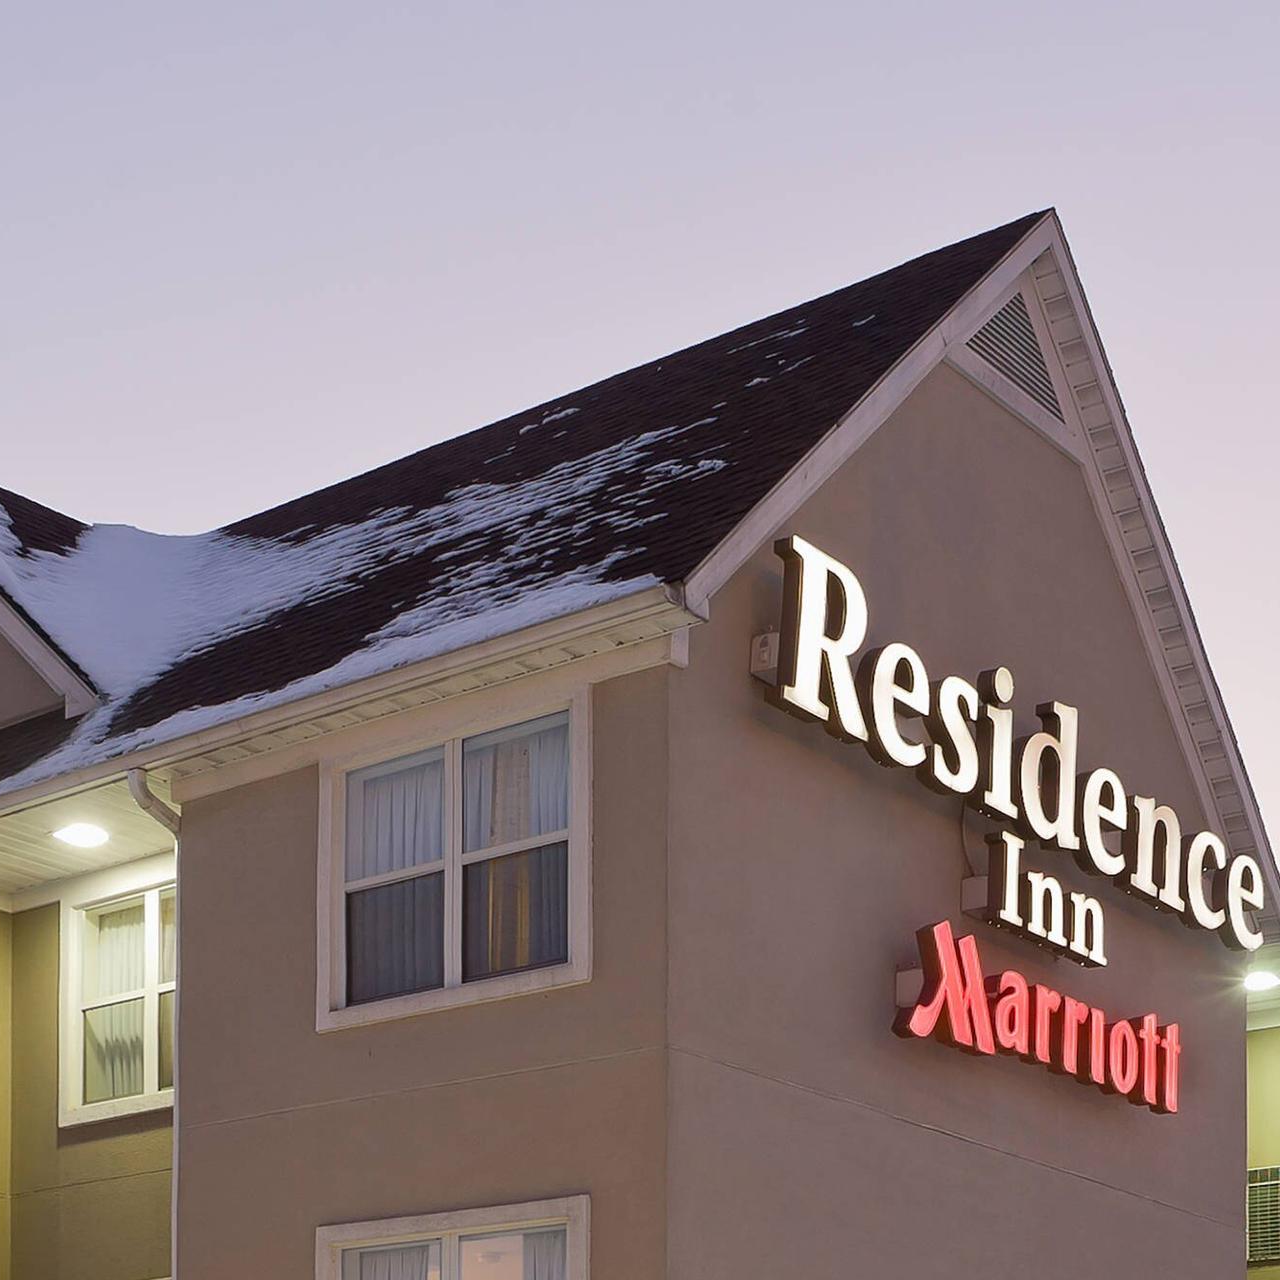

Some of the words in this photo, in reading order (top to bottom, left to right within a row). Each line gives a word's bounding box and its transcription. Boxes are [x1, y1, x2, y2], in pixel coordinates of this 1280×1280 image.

[782, 534, 1264, 951] Residence
[1000, 831, 1107, 966] Inn
[910, 920, 1180, 1113] Marriott
